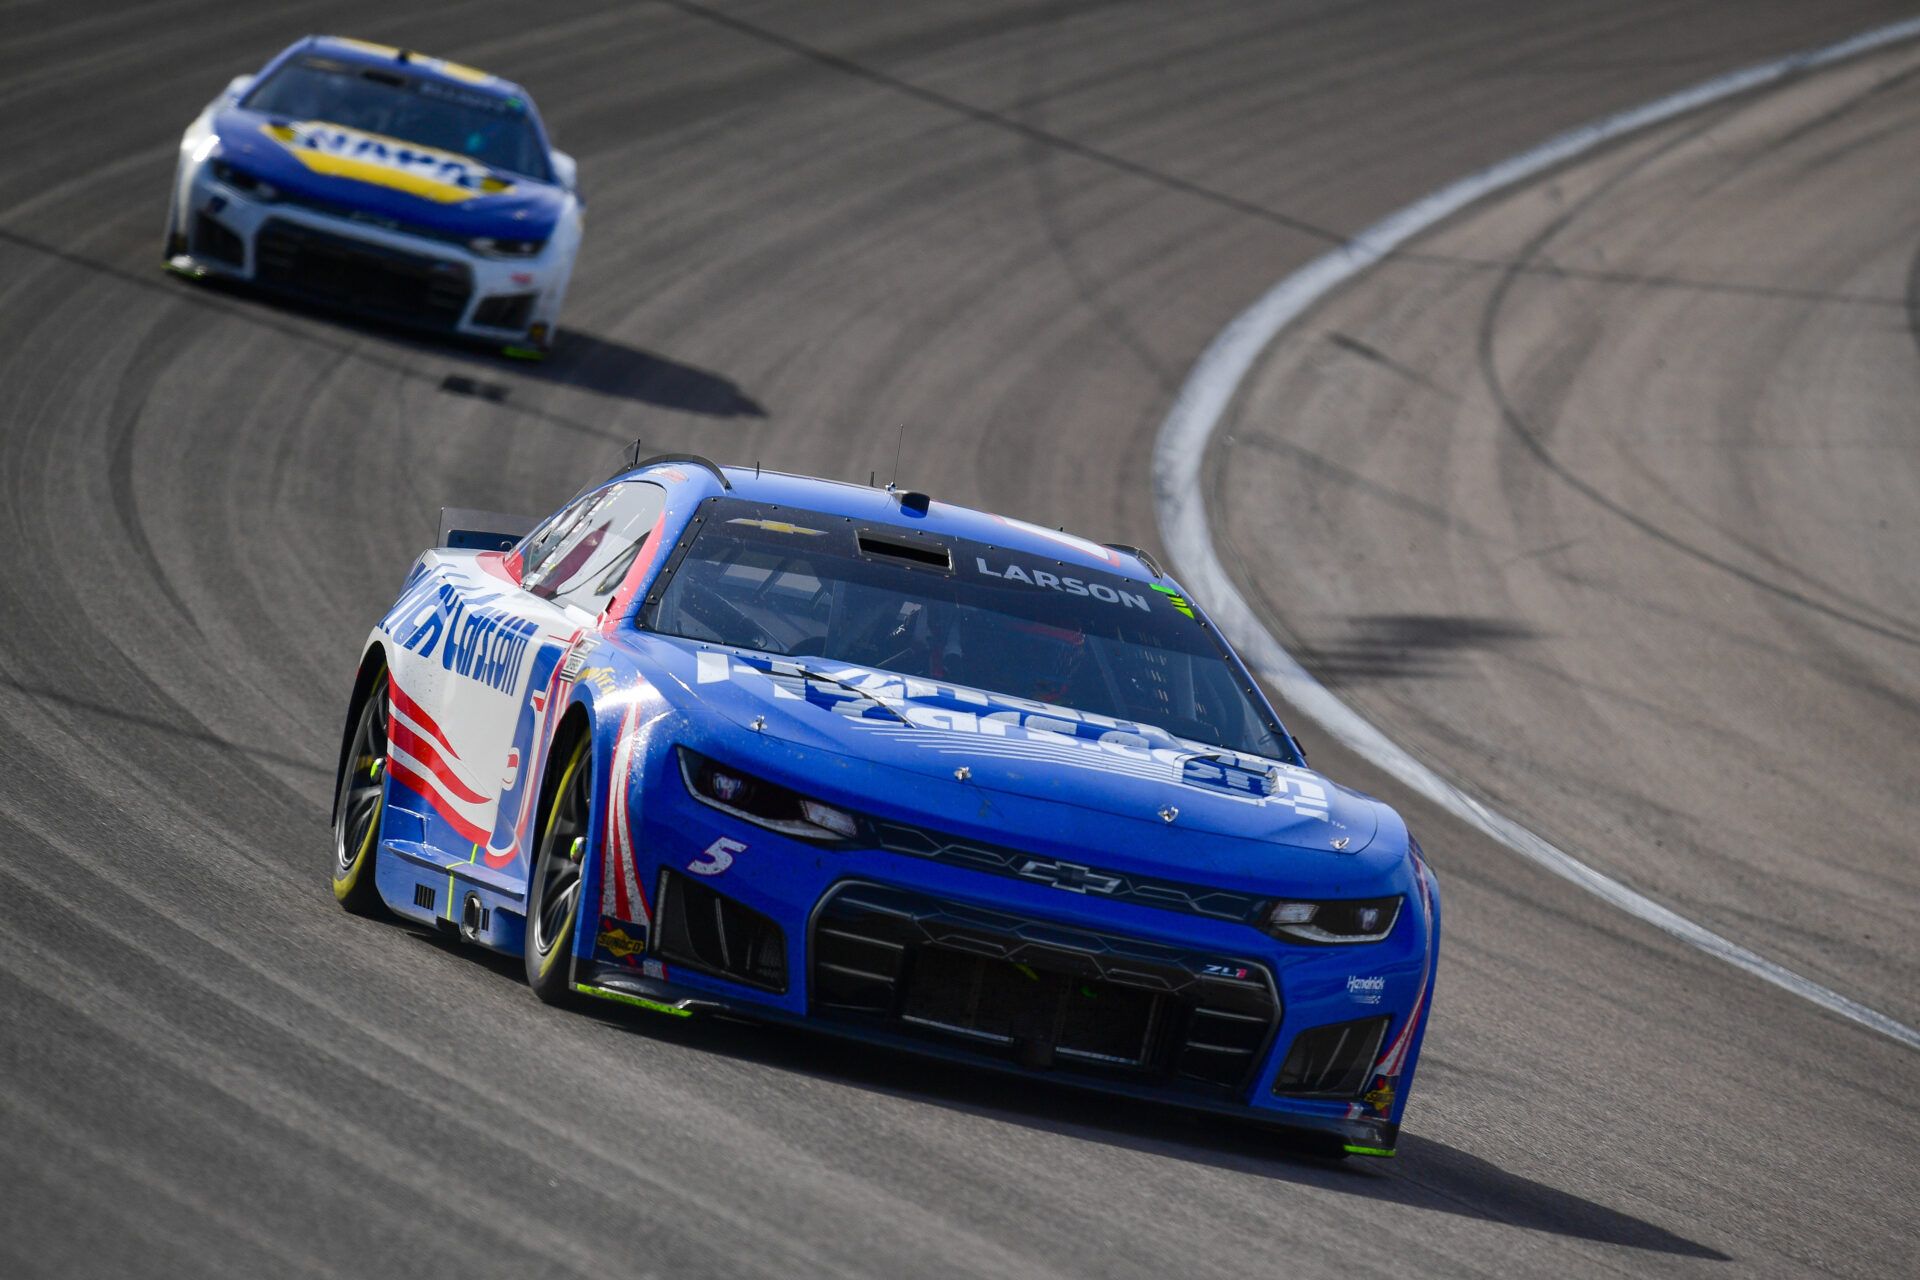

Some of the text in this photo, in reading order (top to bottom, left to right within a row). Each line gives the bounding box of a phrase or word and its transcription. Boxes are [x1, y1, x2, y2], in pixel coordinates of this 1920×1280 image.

[976, 557, 1151, 612] LARSON
[687, 836, 749, 877] 5
[598, 932, 644, 954] SUNOCO
[1346, 975, 1385, 993] Hendrick
